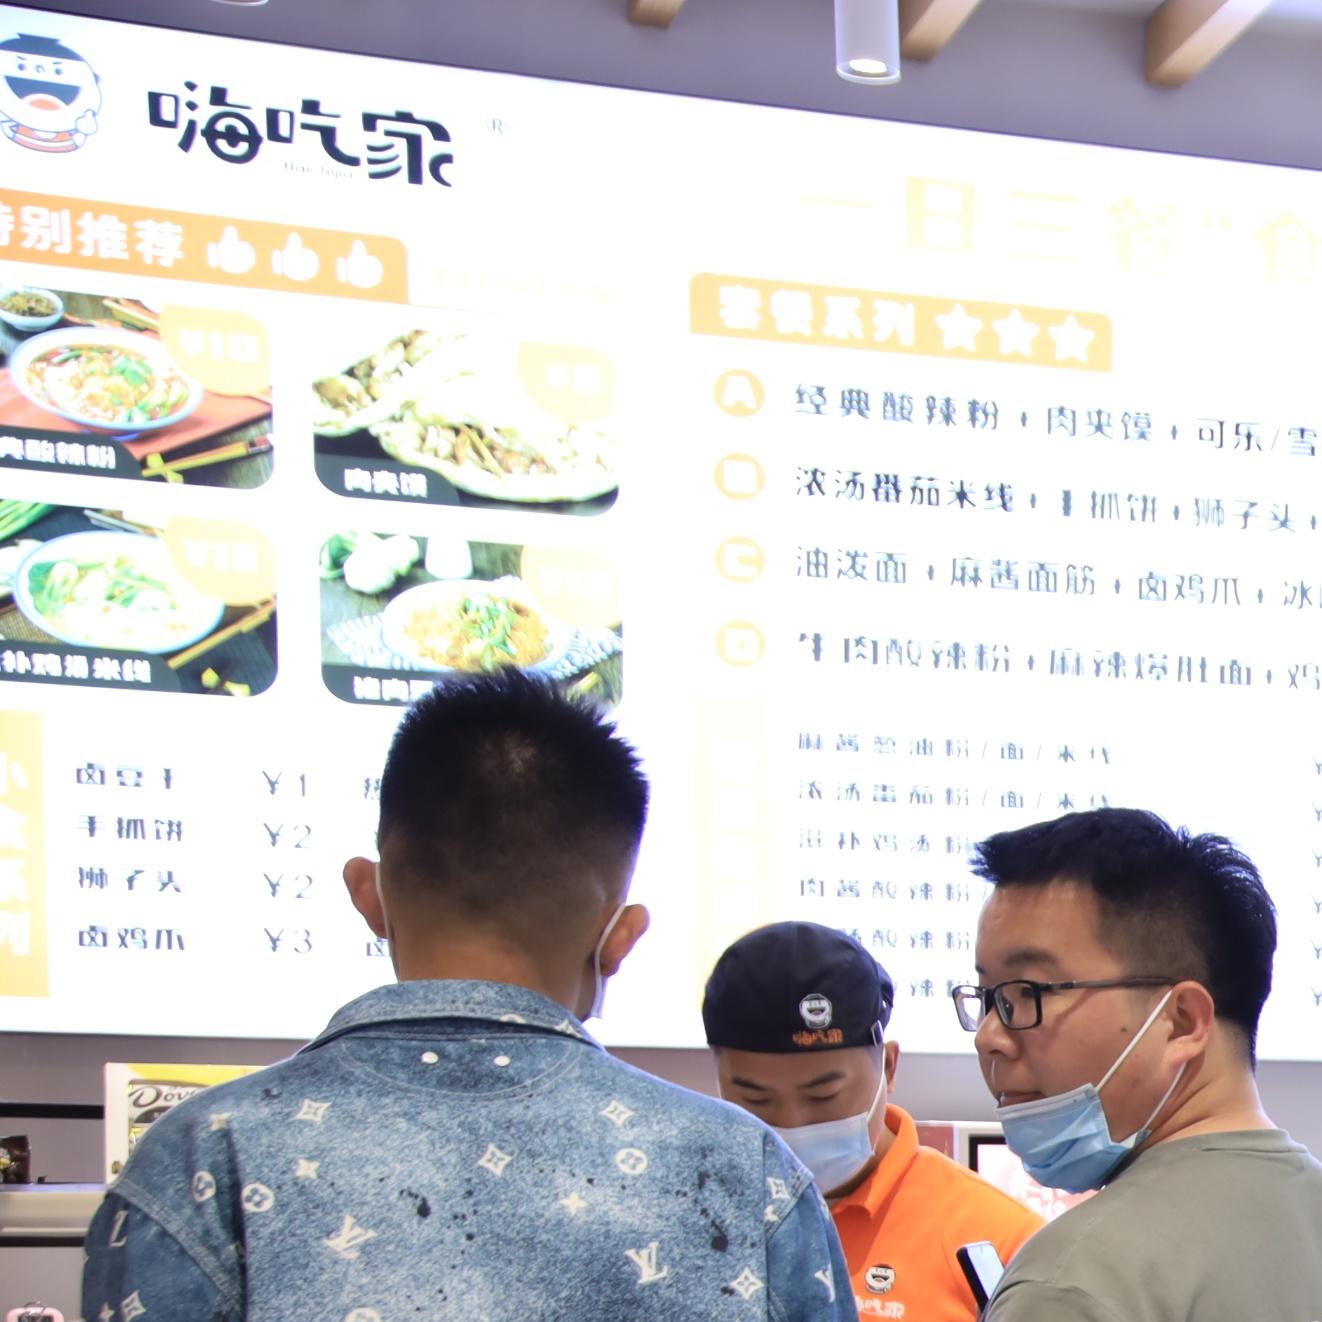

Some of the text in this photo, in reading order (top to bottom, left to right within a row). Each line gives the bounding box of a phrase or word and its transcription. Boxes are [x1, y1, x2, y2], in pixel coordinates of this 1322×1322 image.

[148, 81, 454, 187] 嗨吃家
[0, 206, 184, 268] 别推荐
[262, 770, 307, 797] ¥1
[263, 822, 313, 849] ¥2
[263, 872, 313, 899] ¥2
[78, 925, 186, 951] 卤鸡爪
[264, 927, 313, 954] ¥3
